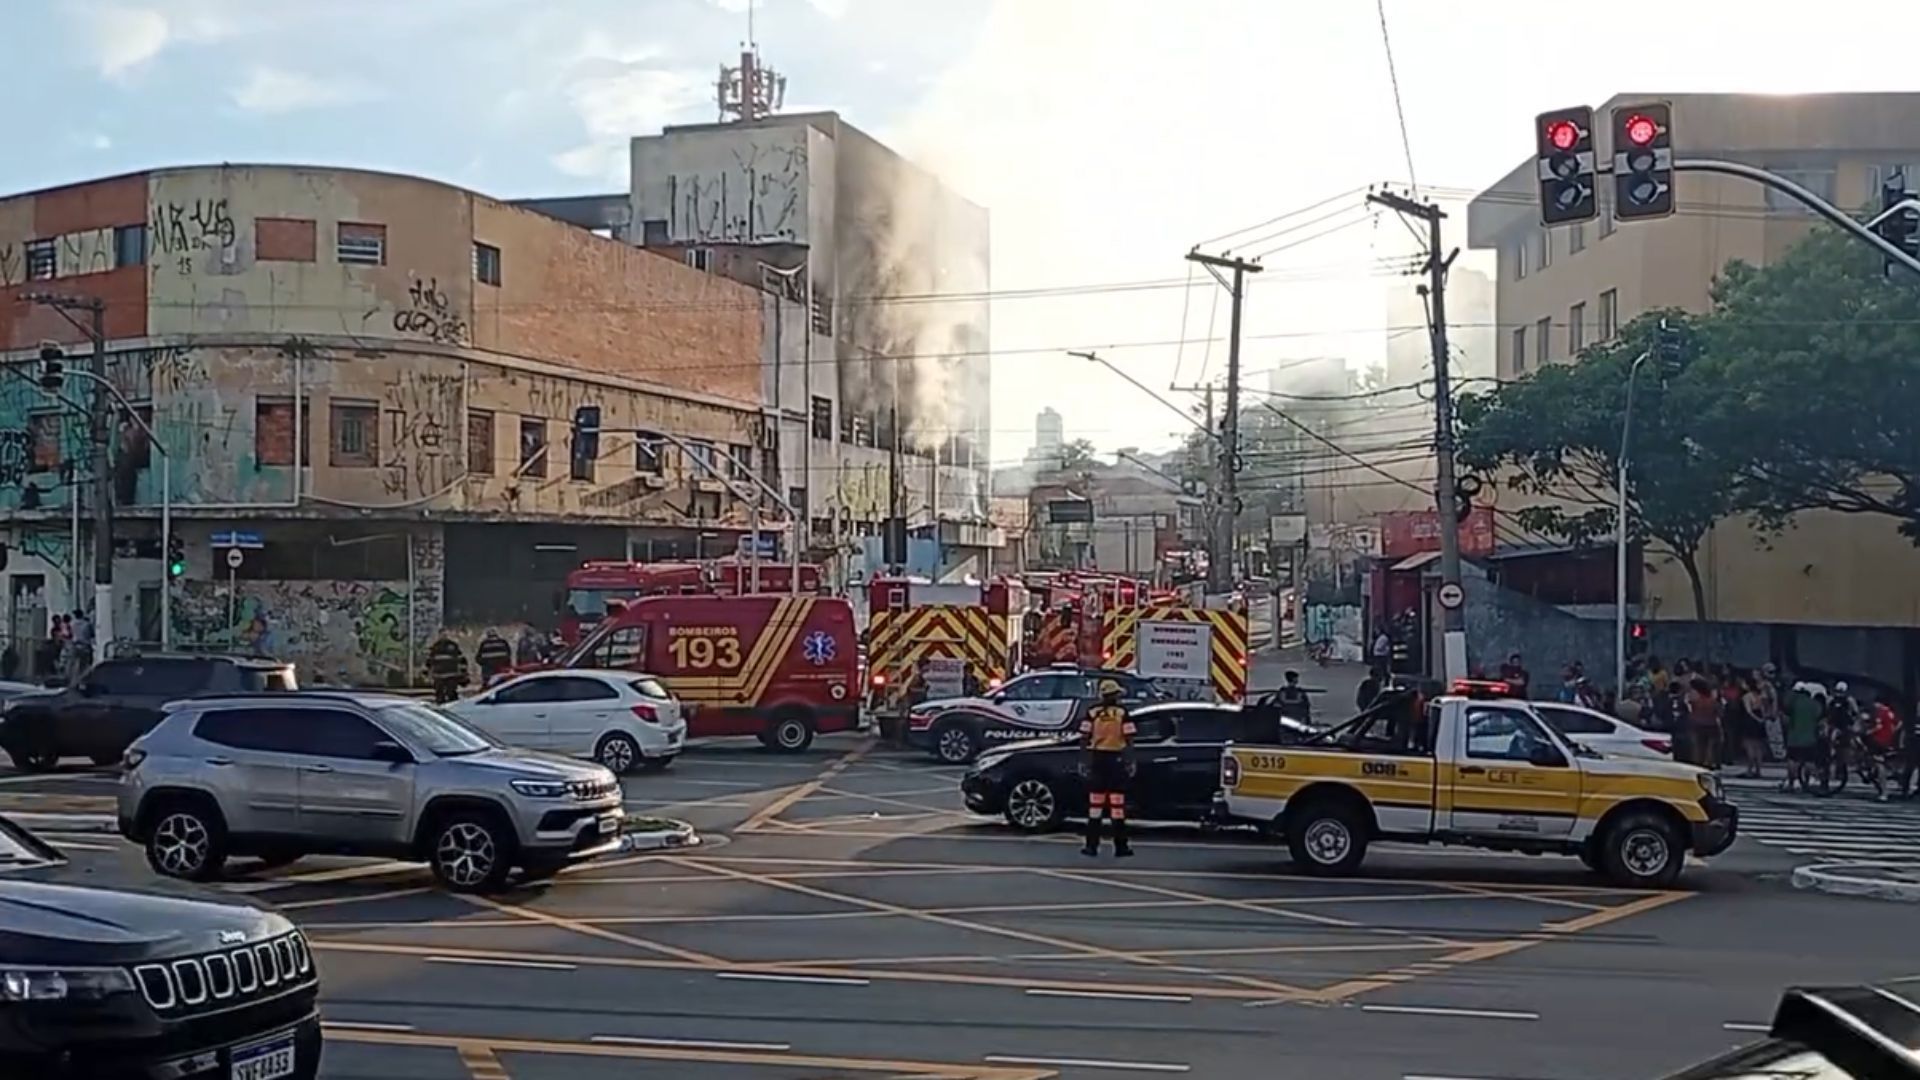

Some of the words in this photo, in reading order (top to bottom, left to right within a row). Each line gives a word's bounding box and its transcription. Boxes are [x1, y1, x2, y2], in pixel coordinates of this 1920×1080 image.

[668, 626, 738, 637] BOMBEIROS
[668, 637, 741, 669] 193
[1251, 756, 1286, 770] 0319
[1487, 769, 1519, 784] CET
